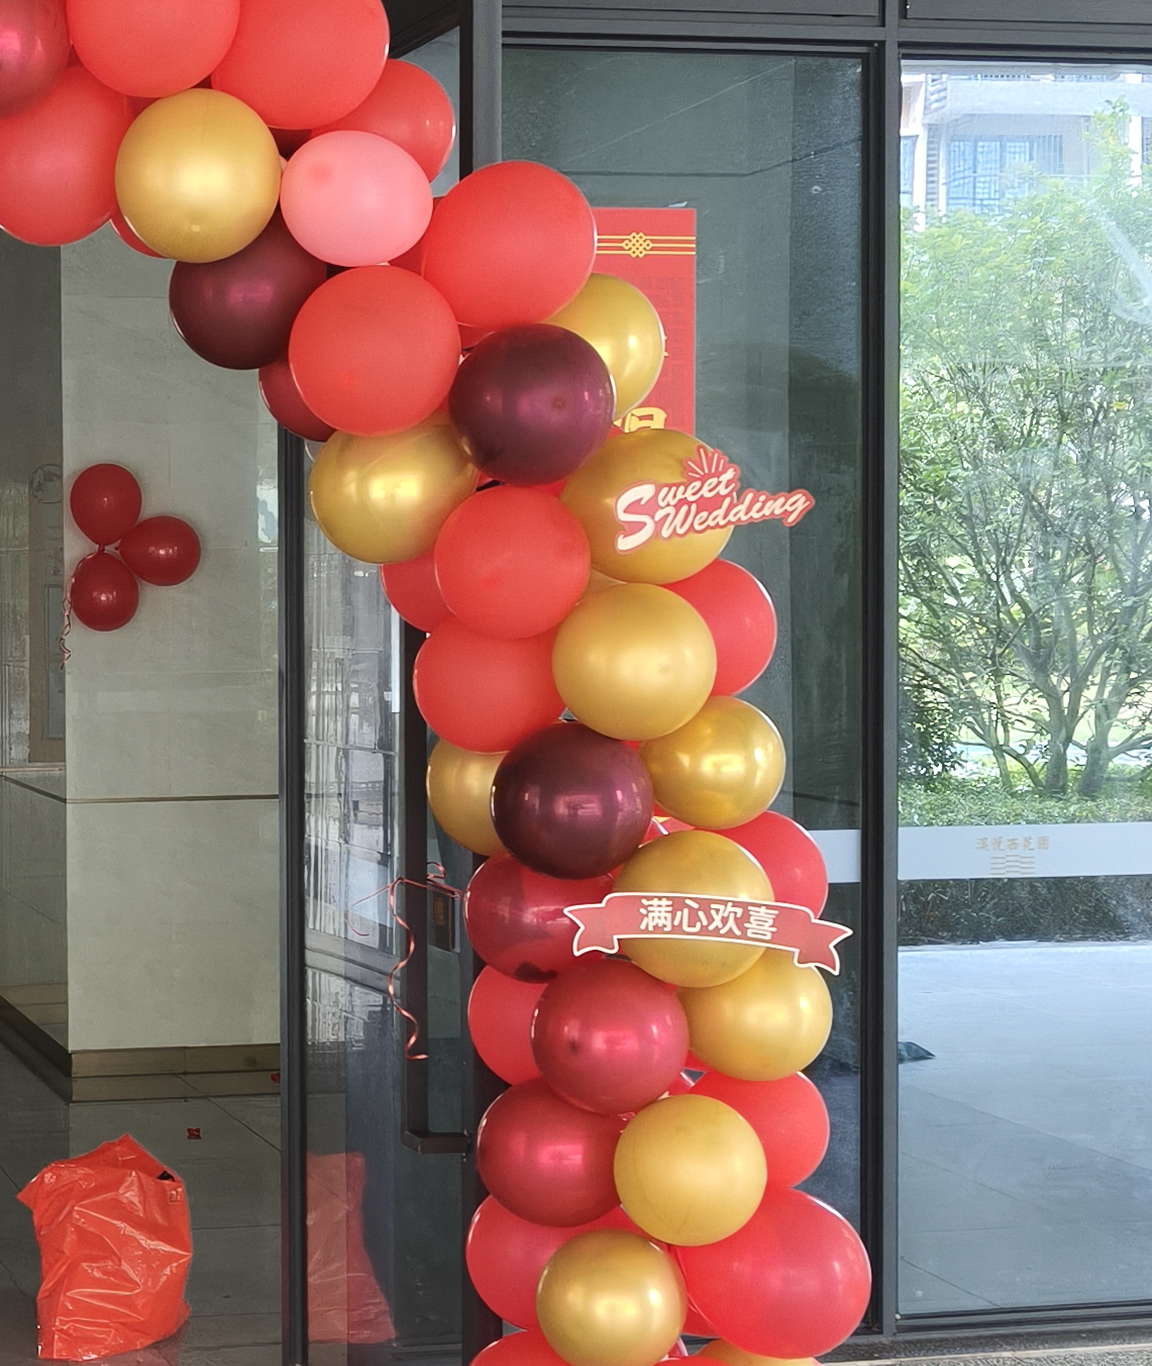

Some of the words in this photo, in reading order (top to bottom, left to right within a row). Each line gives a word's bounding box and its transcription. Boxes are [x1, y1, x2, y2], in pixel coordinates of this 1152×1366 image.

[617, 468, 736, 550] Sweet
[654, 493, 811, 539] Wedding
[639, 898, 779, 940] 满心欢喜
